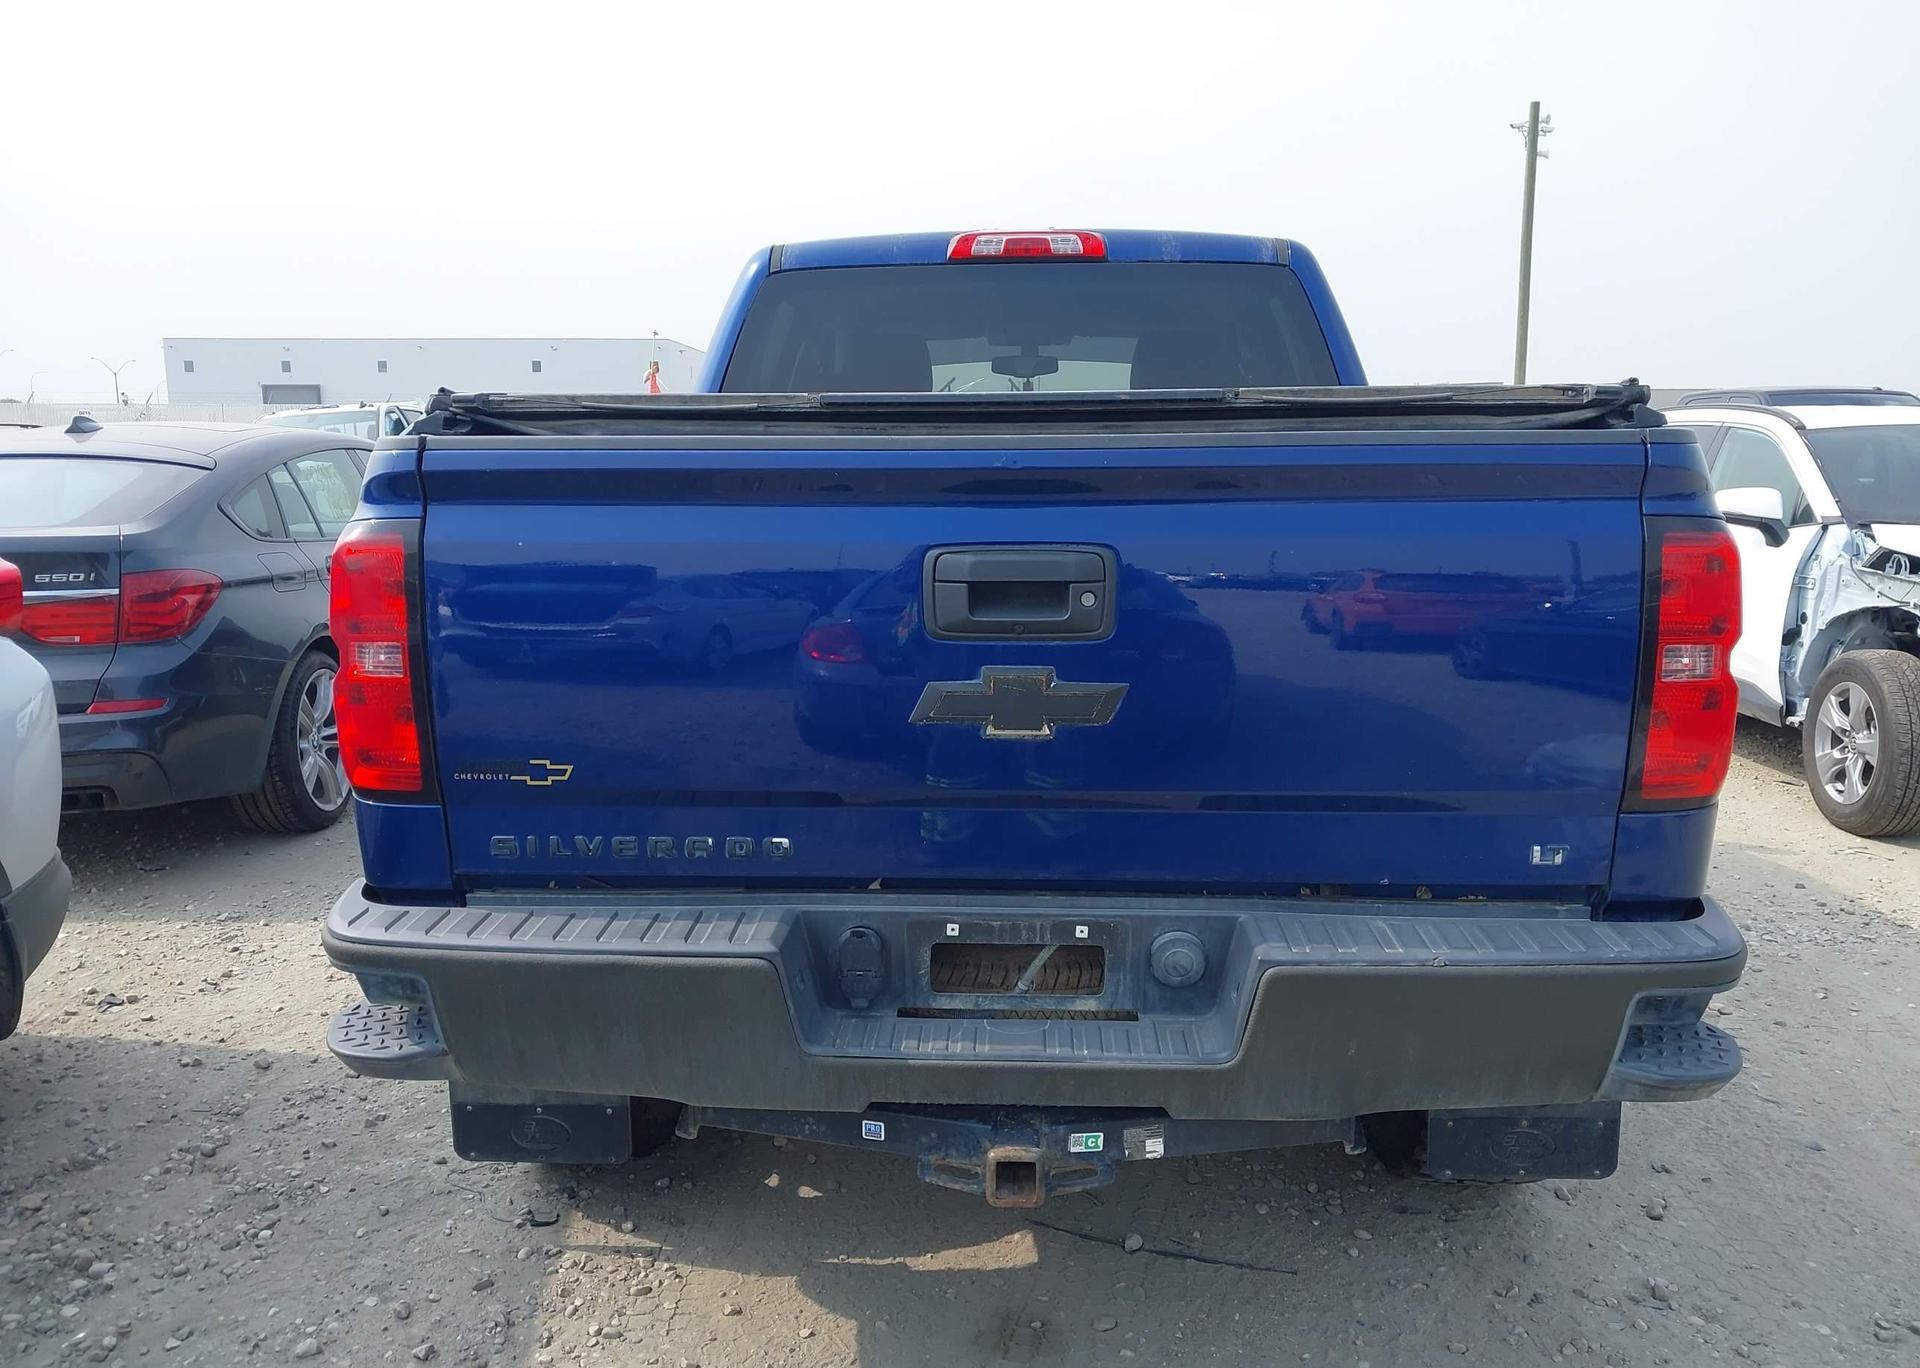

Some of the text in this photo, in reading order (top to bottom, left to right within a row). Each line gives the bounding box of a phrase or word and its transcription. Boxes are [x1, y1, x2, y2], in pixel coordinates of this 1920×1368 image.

[489, 835, 794, 859] SILVERADO
[1530, 844, 1570, 865] LT
[866, 1124, 880, 1132] PRO
